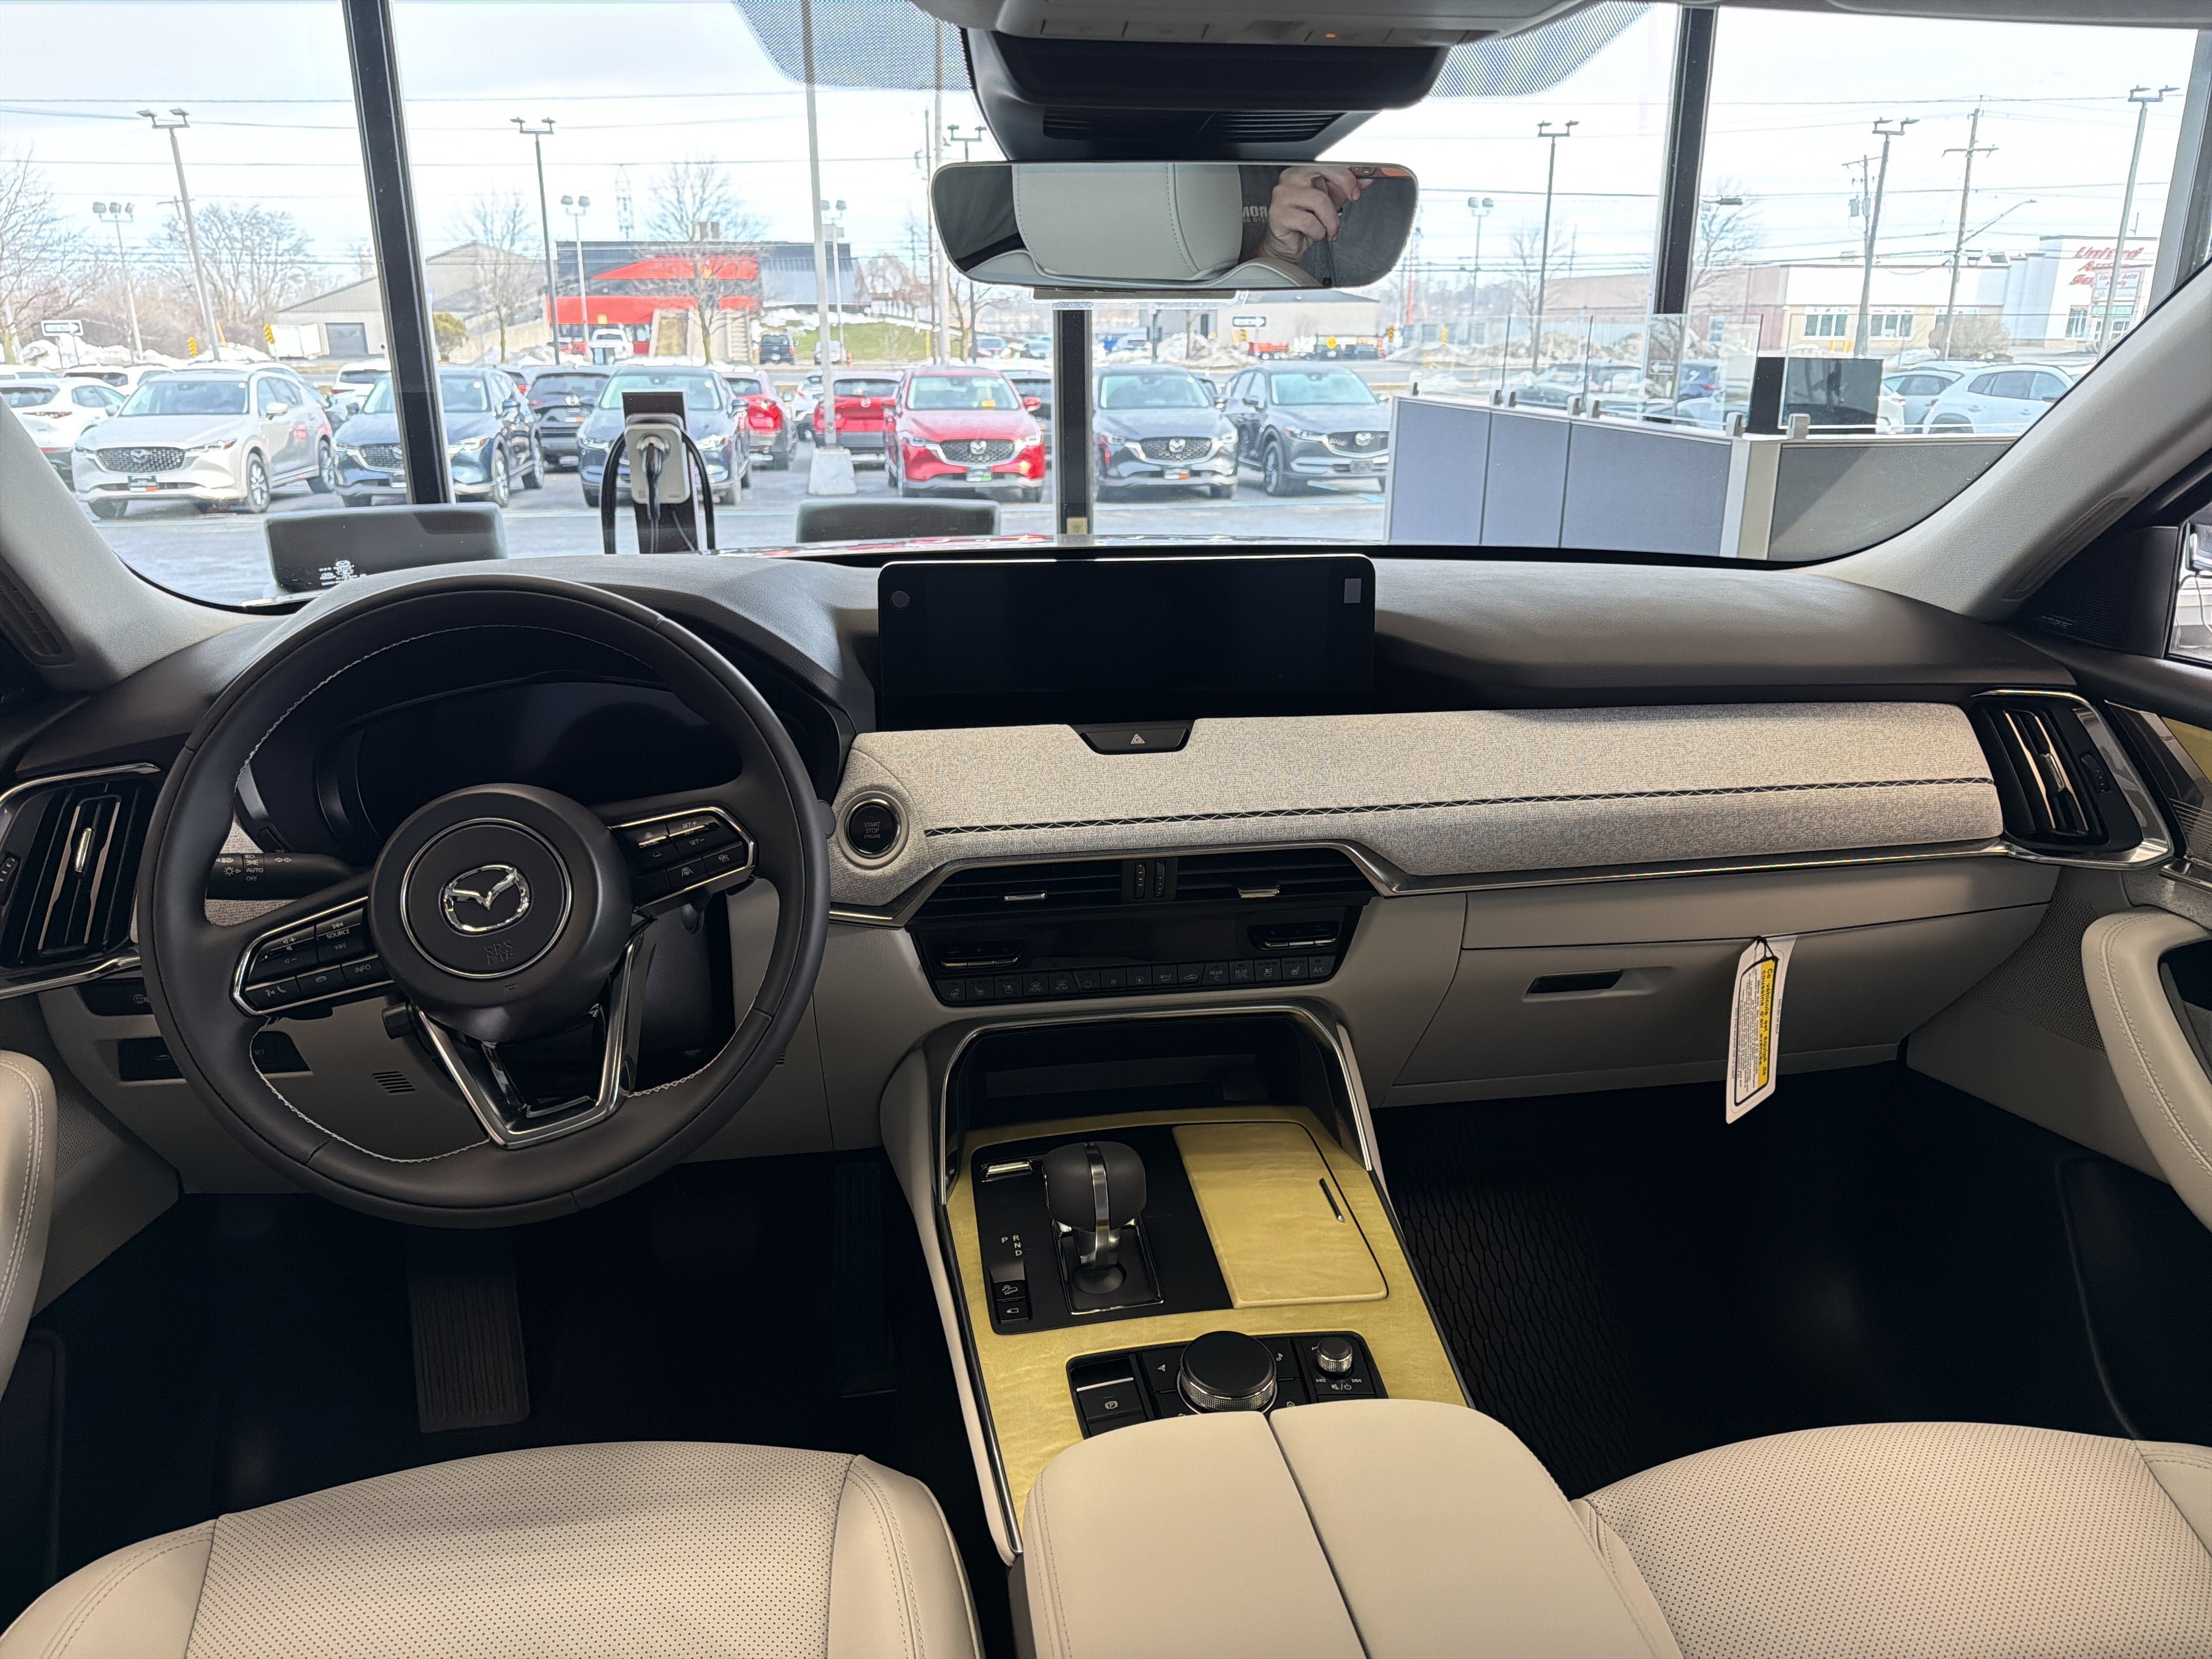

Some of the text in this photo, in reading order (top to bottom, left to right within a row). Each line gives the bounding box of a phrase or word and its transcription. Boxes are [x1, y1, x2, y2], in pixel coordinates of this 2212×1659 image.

[326, 928, 351, 939] SOURCE
[354, 964, 371, 973] INFO
[1767, 968, 1773, 979] Ce
[1763, 1066, 1767, 1076] de
